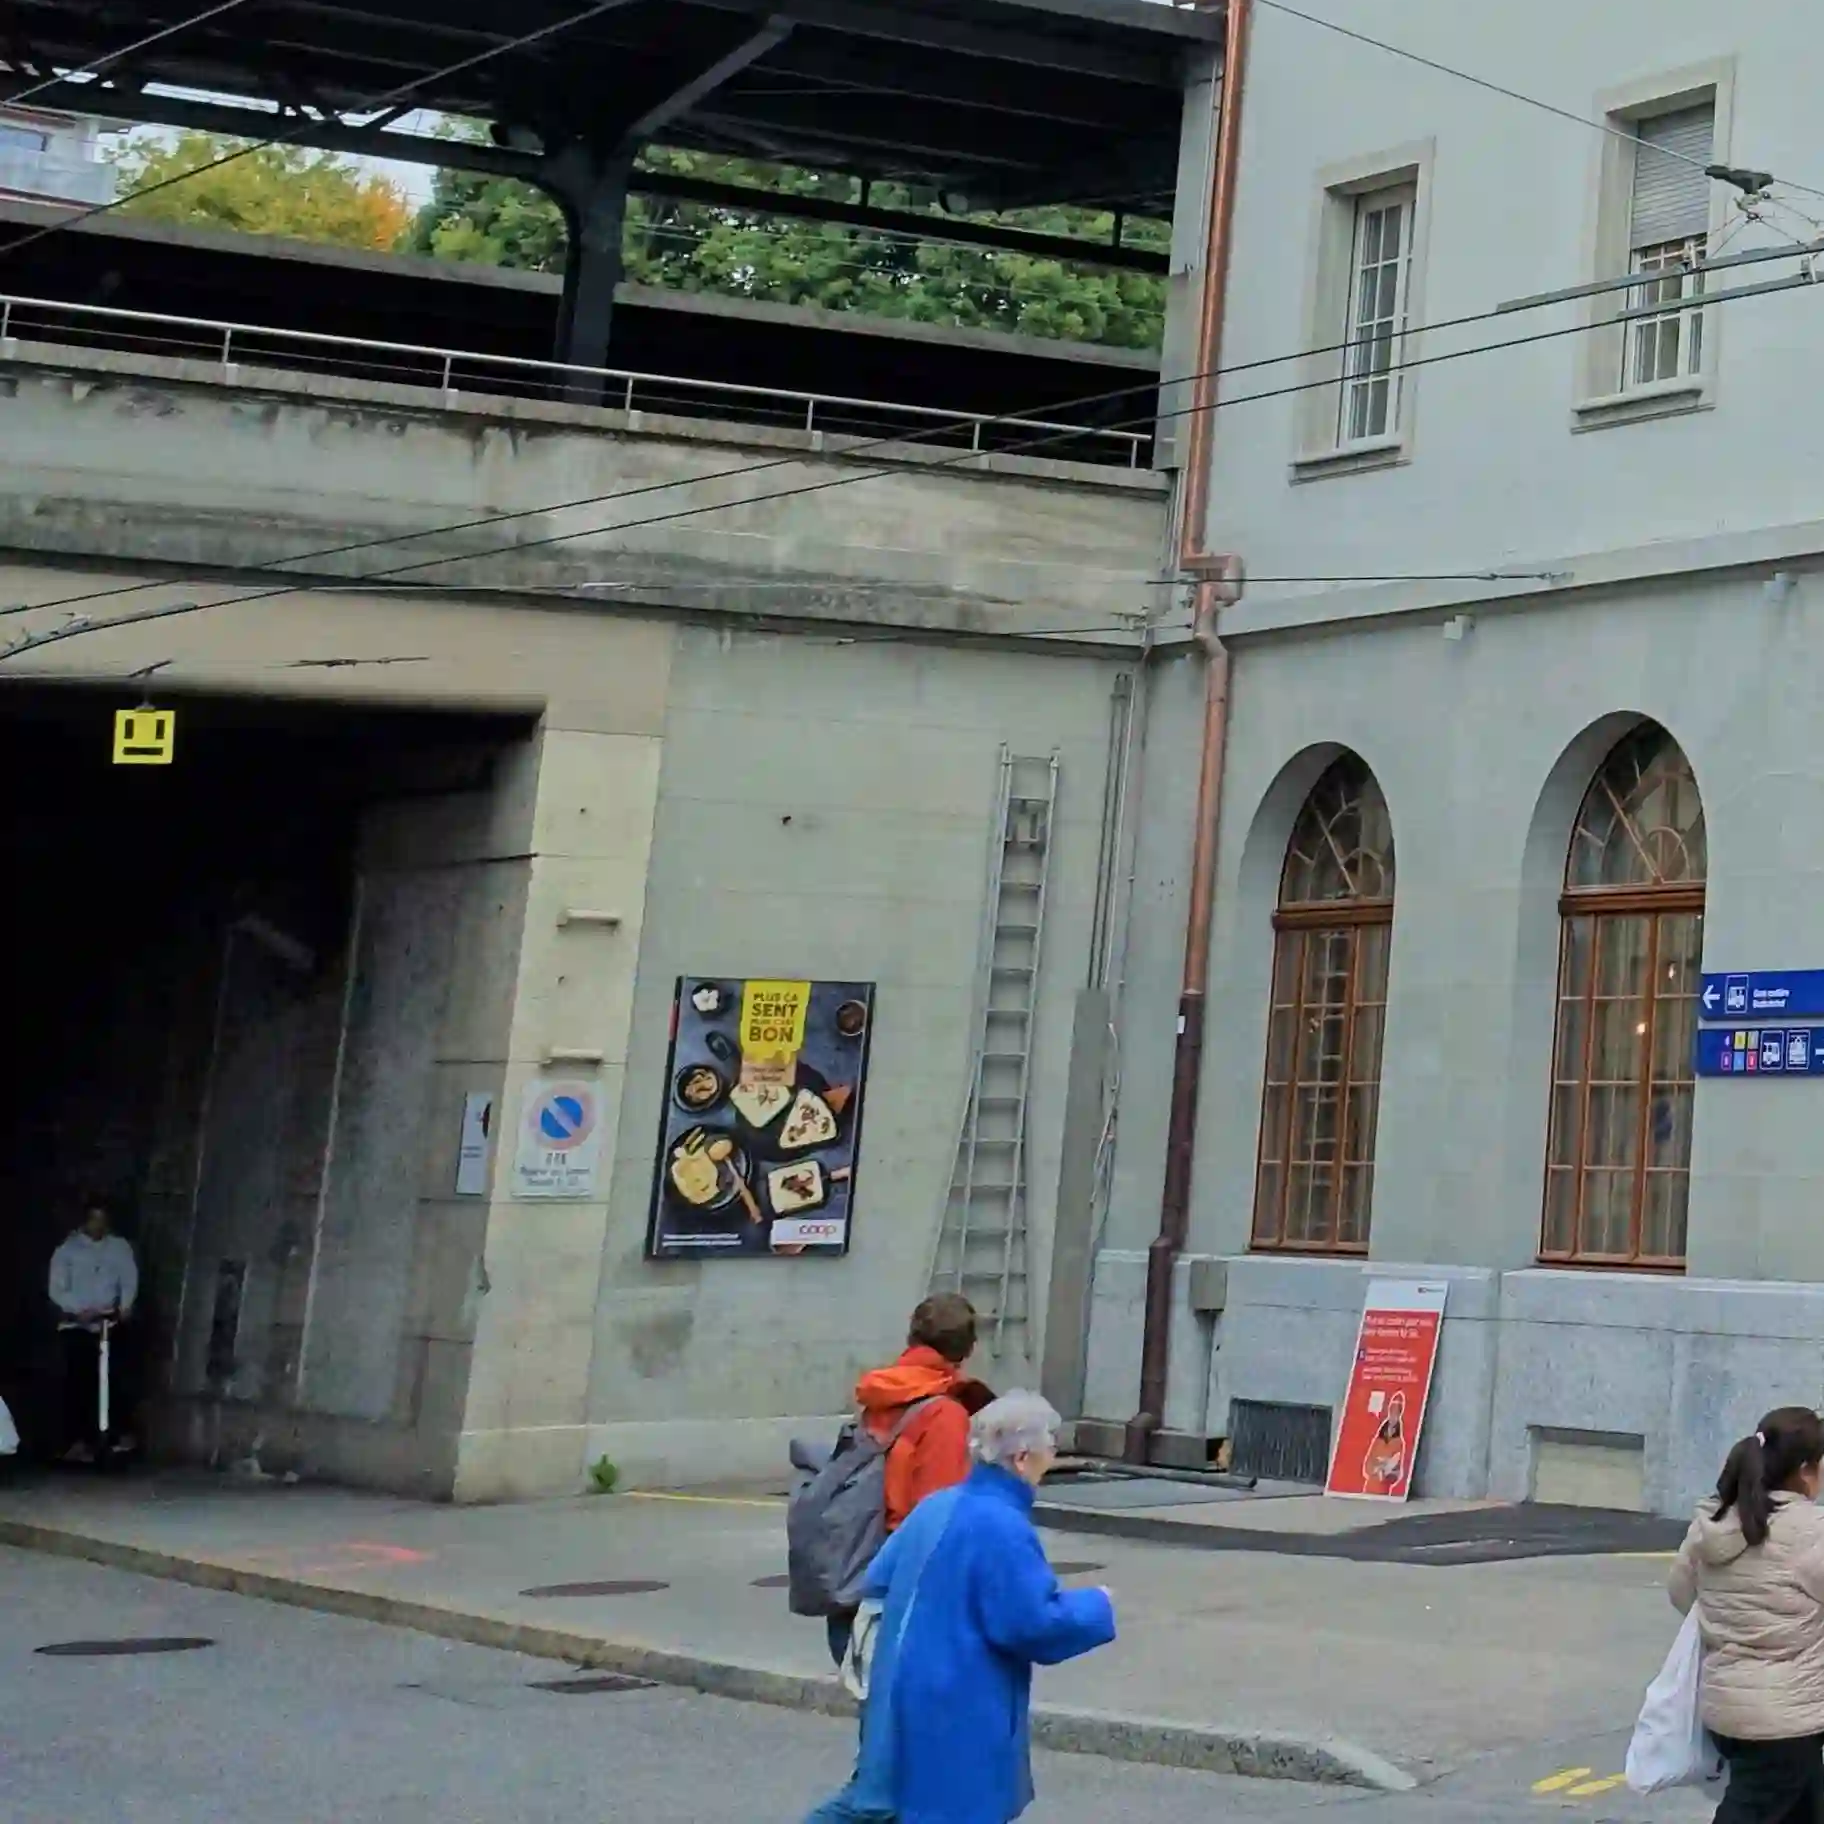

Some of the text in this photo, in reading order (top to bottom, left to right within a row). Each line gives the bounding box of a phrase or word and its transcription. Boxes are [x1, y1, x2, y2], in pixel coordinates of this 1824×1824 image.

[751, 1003, 798, 1017] SENT
[749, 1026, 793, 1042] BON
[799, 1224, 836, 1238] coop
